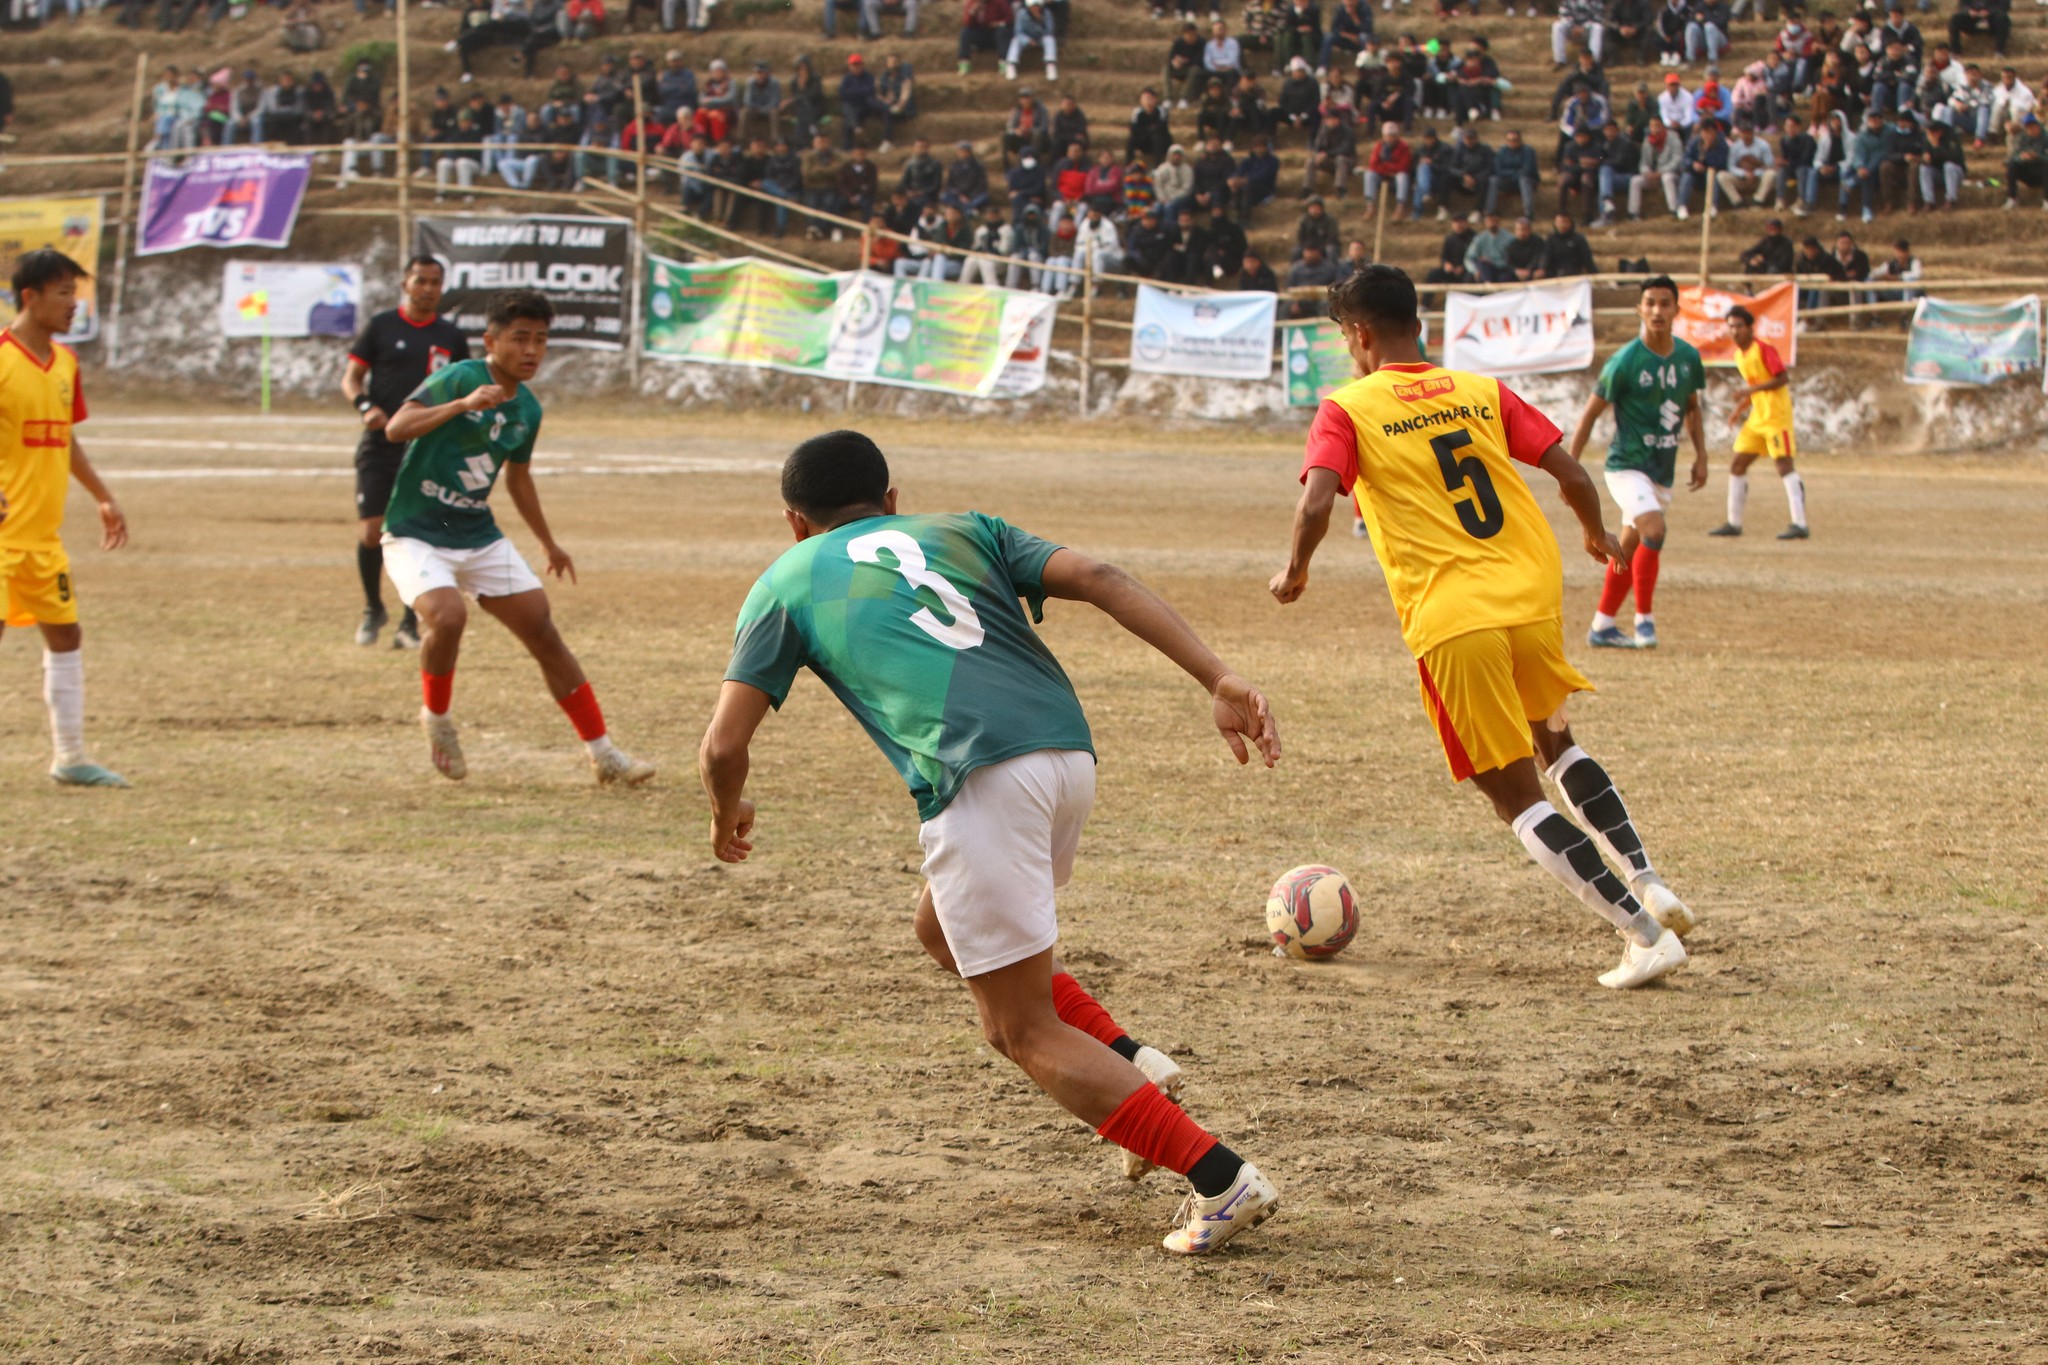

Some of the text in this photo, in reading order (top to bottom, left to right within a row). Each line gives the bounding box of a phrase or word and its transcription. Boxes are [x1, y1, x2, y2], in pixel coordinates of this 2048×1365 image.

[181, 206, 249, 240] TVS
[452, 225, 605, 248] WELCOME TO ILAM
[1657, 364, 1677, 389] 14
[1382, 405, 1472, 437] PANCHTHAR
[1429, 428, 1504, 539] 5
[58, 573, 70, 602] 9
[847, 530, 985, 650] 3
